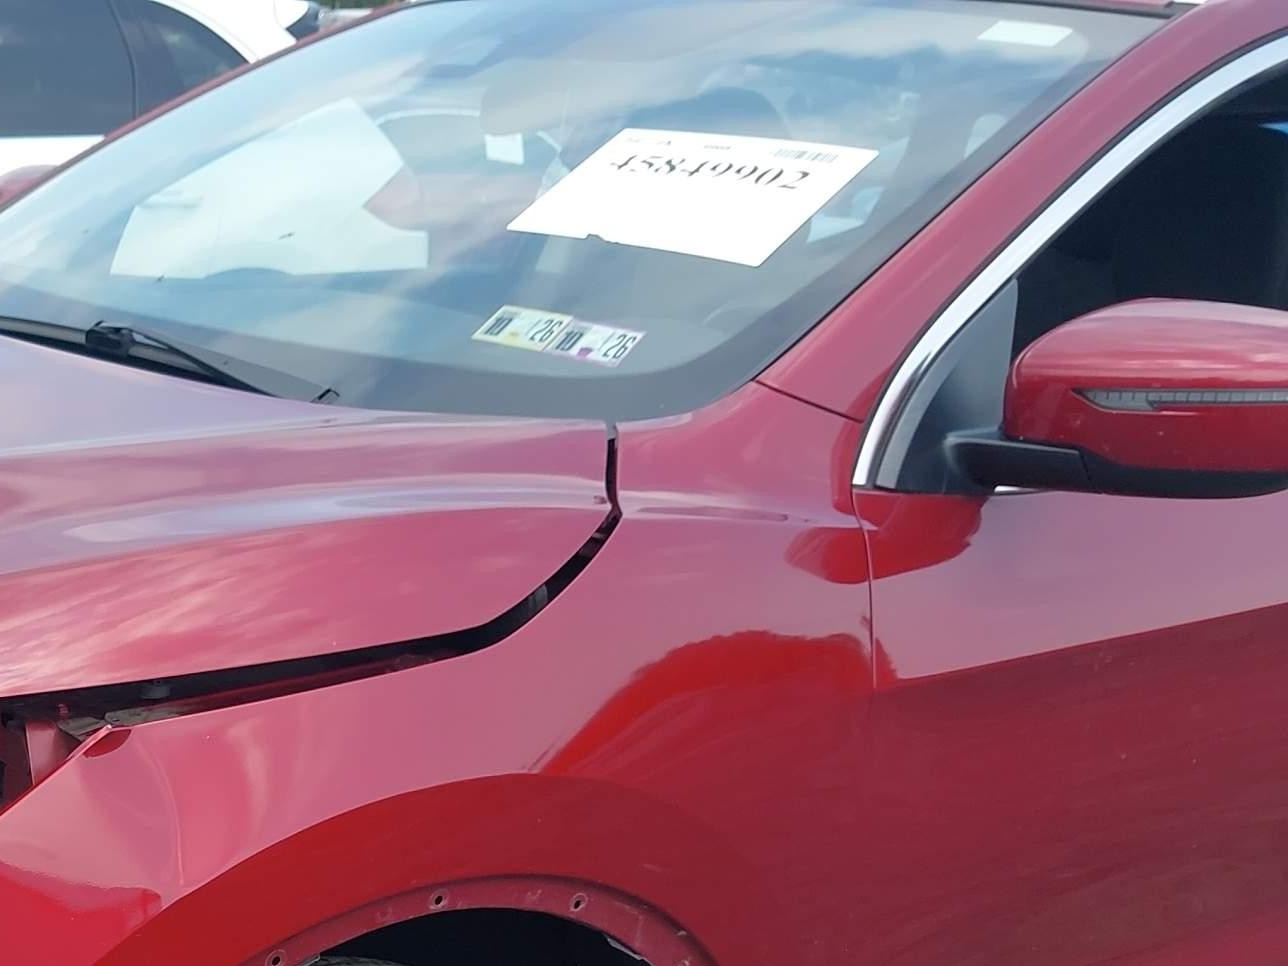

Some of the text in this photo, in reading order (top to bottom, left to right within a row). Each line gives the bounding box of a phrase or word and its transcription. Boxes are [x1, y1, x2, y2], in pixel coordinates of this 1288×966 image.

[609, 153, 811, 190] 45849902
[529, 318, 563, 343] 26
[602, 333, 637, 359] 26
